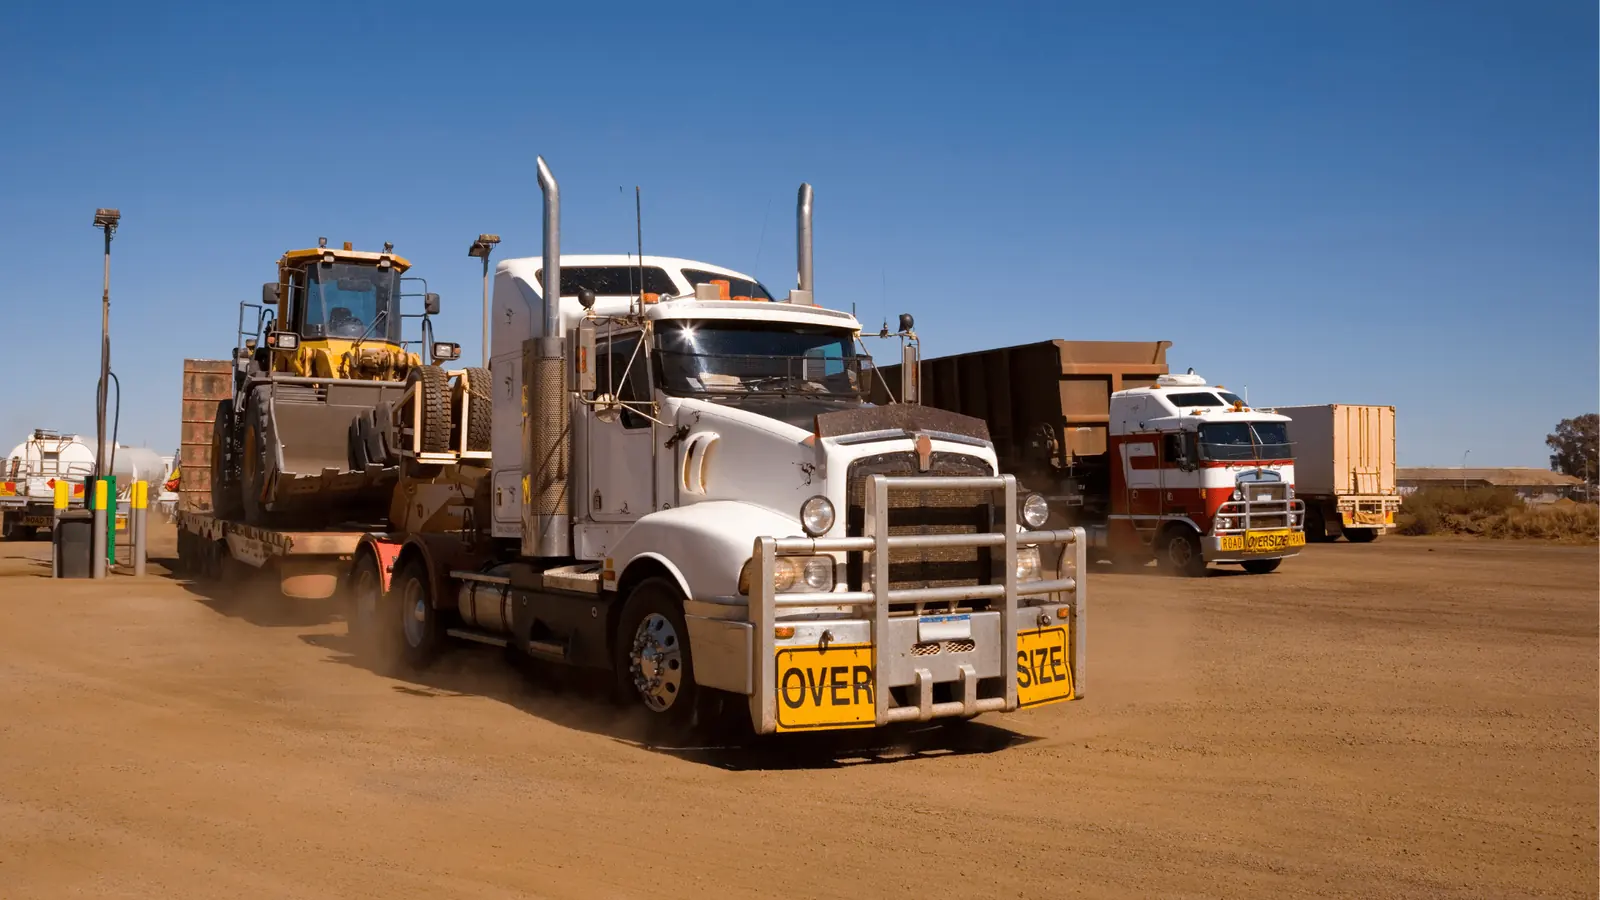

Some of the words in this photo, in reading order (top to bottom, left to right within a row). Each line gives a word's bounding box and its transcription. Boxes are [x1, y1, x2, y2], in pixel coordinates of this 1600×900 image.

[1223, 538, 1242, 549] ROAD
[1247, 535, 1289, 548] OVERSIZE
[782, 665, 874, 709] OVER
[1017, 646, 1066, 688] SIZE
